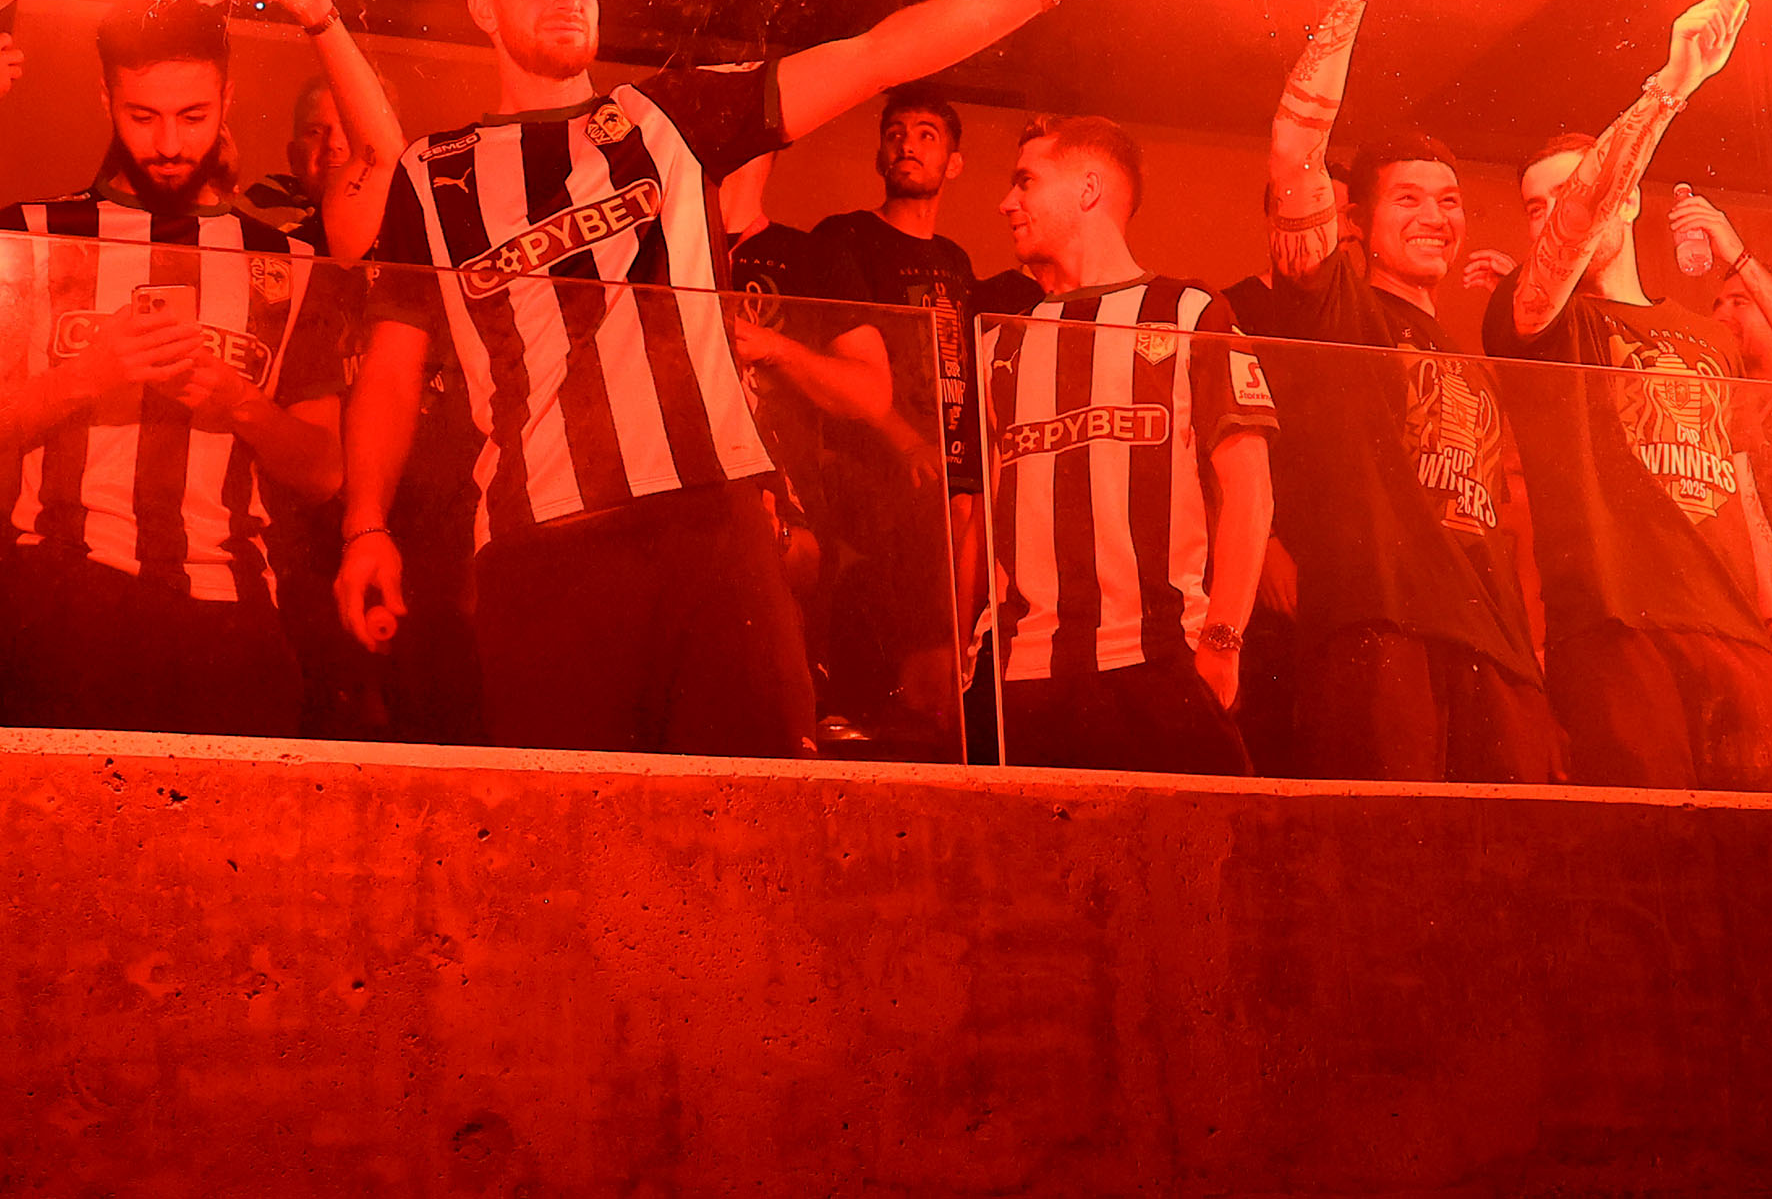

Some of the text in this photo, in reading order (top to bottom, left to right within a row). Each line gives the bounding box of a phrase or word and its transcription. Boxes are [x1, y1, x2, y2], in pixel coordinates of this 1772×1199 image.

[422, 135, 478, 160] ZEMCO
[1676, 423, 1700, 447] CUP
[1443, 447, 1474, 475] CUP
[1641, 443, 1736, 493] WINNERS
[1679, 480, 1707, 499] 2025
